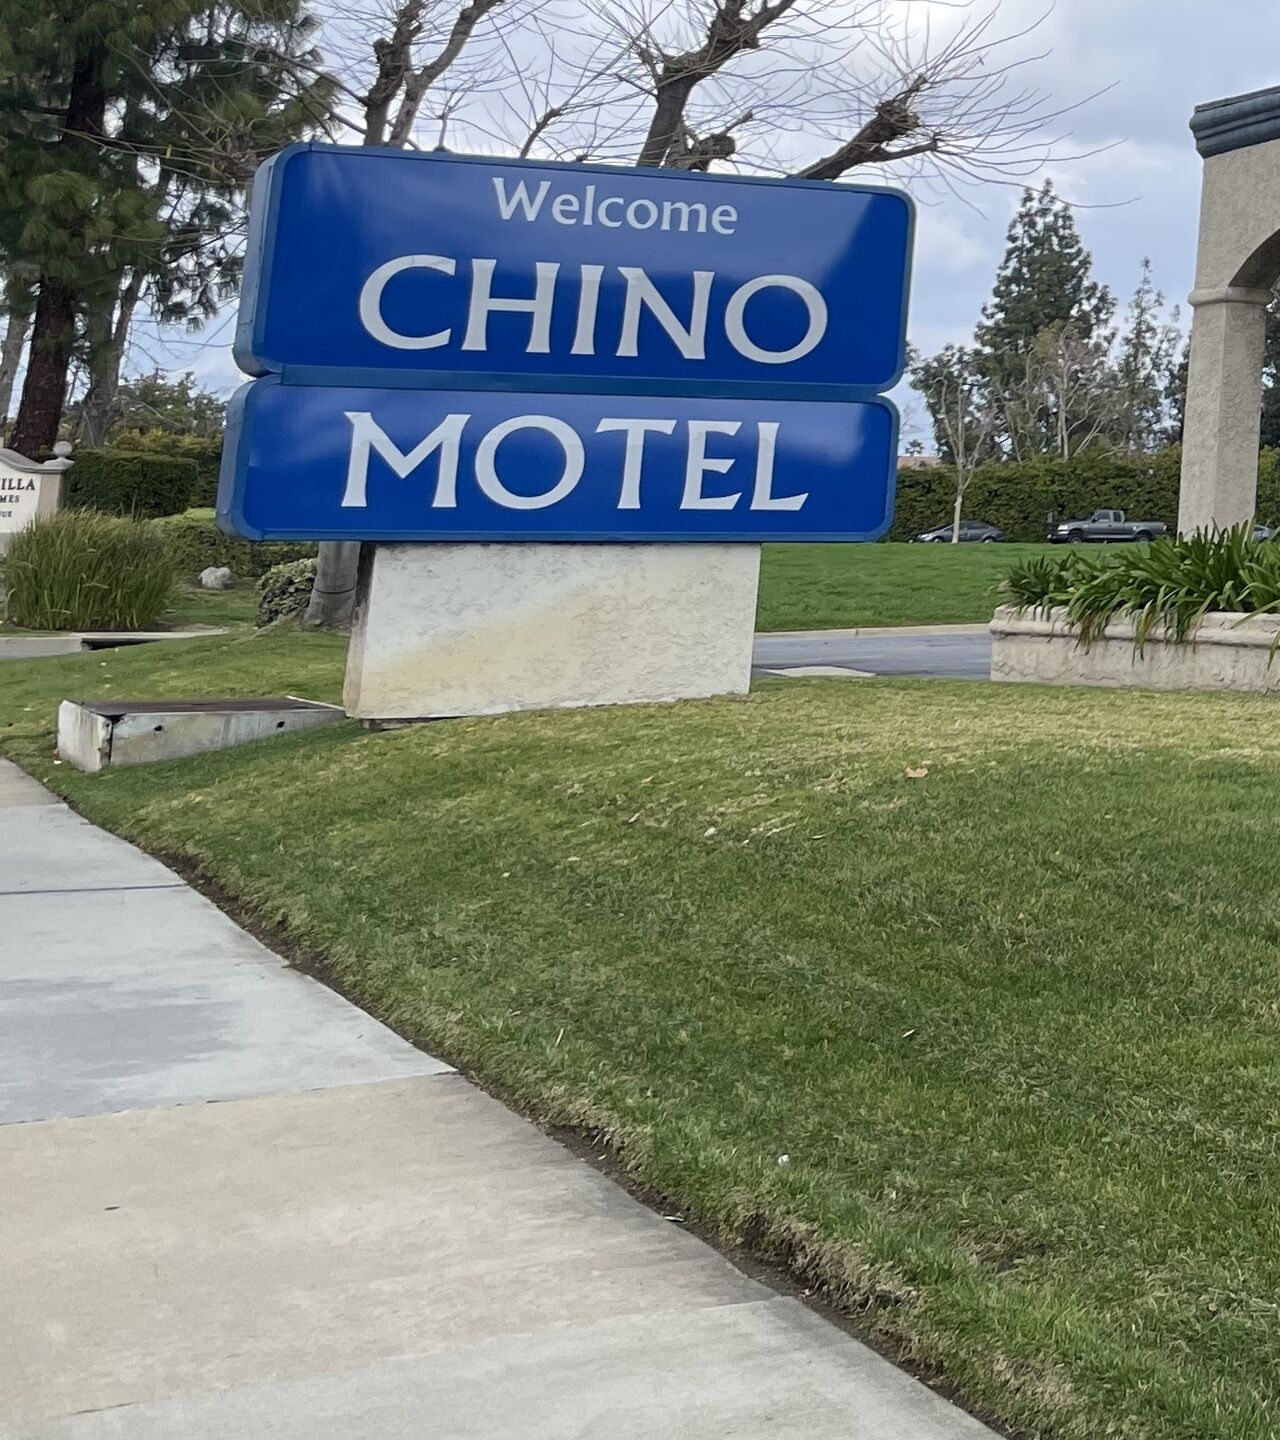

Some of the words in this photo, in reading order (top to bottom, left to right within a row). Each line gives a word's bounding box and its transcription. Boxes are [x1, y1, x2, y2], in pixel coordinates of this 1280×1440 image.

[491, 176, 738, 235] Welcome
[359, 254, 828, 364] CHINO
[0, 477, 36, 491] ILLA
[341, 411, 809, 511] MOTEL
